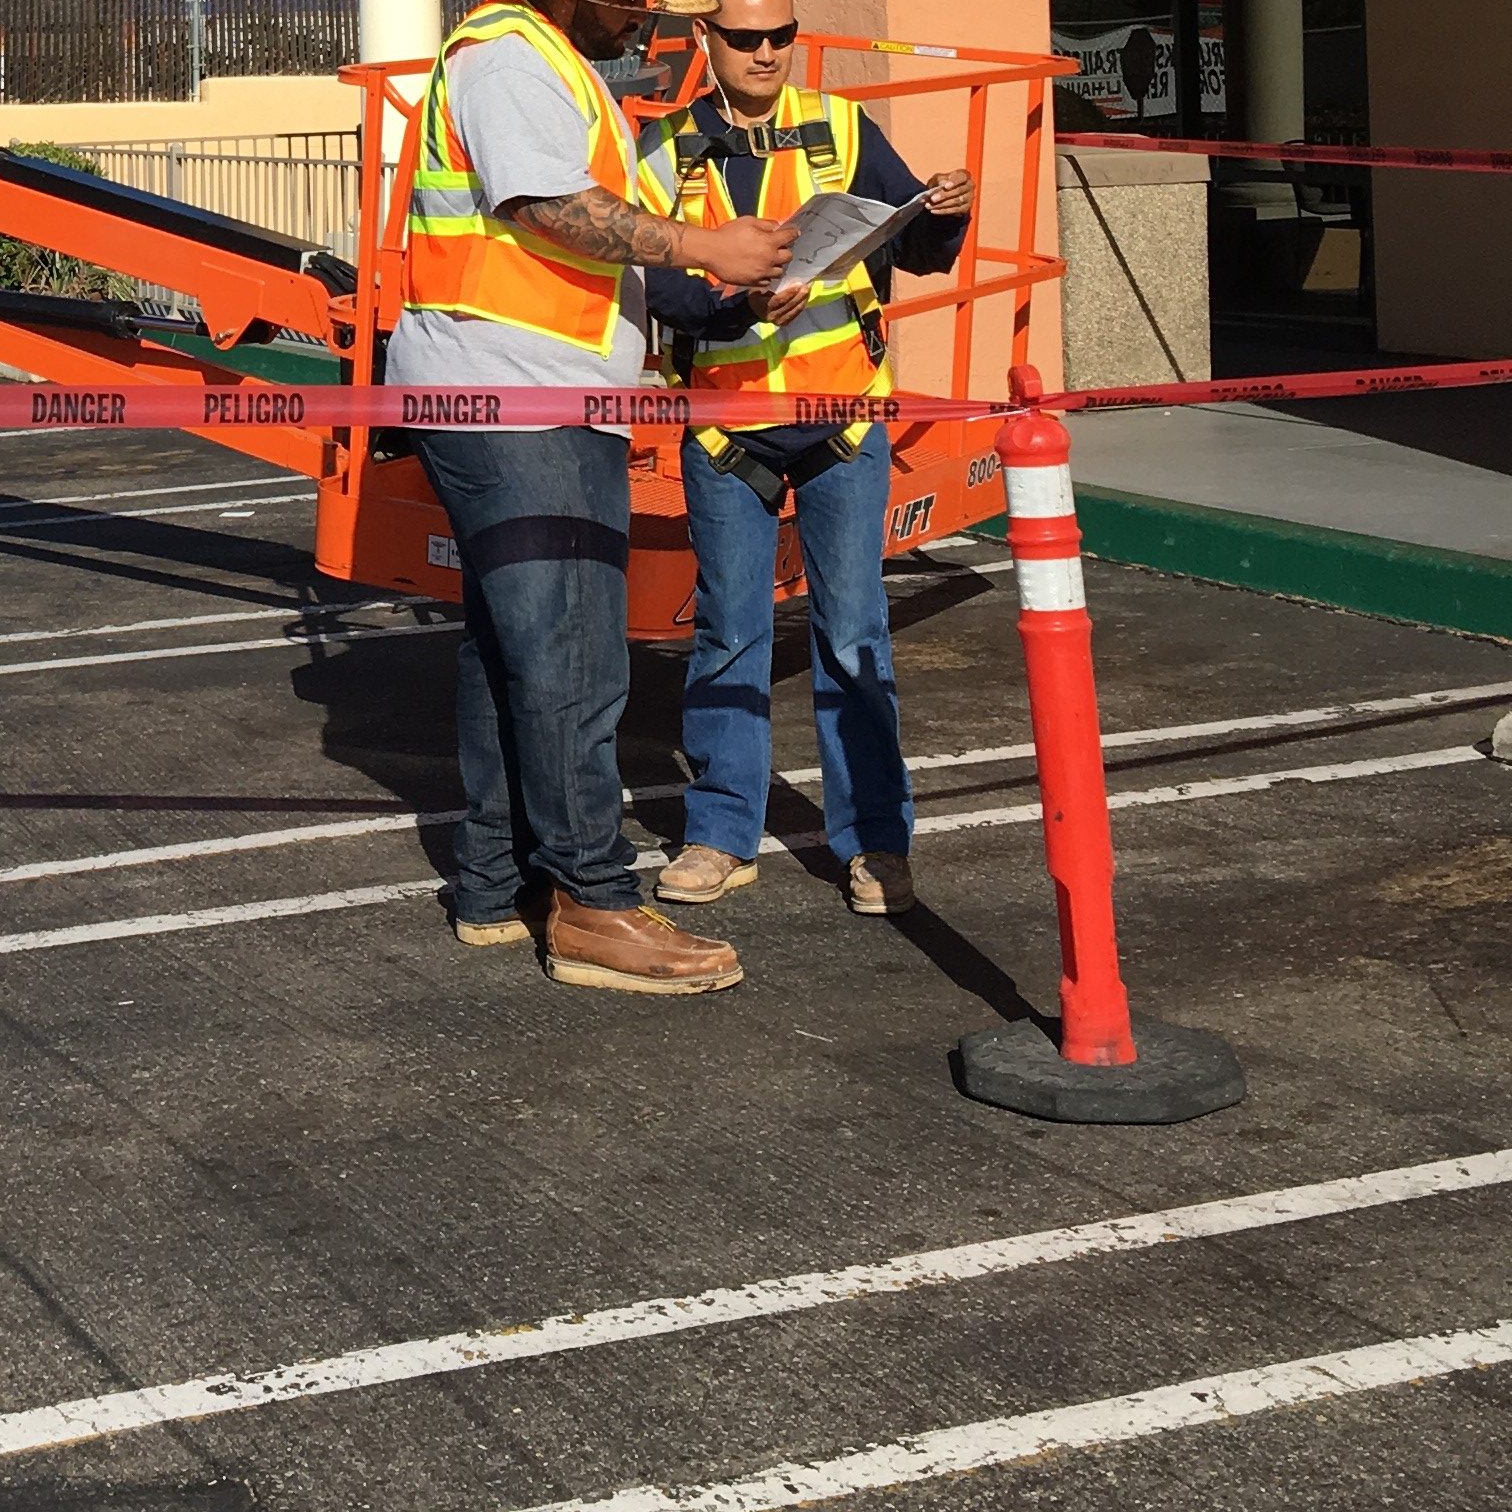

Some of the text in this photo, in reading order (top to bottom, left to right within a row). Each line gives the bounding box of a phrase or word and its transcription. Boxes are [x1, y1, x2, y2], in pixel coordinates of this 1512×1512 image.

[31, 392, 126, 424] DANGER
[203, 392, 305, 424] PELIGRO
[402, 393, 501, 424] DANGER
[583, 394, 690, 426] PELIGRO
[795, 397, 900, 425] DANGER
[890, 494, 937, 541] LIFT
